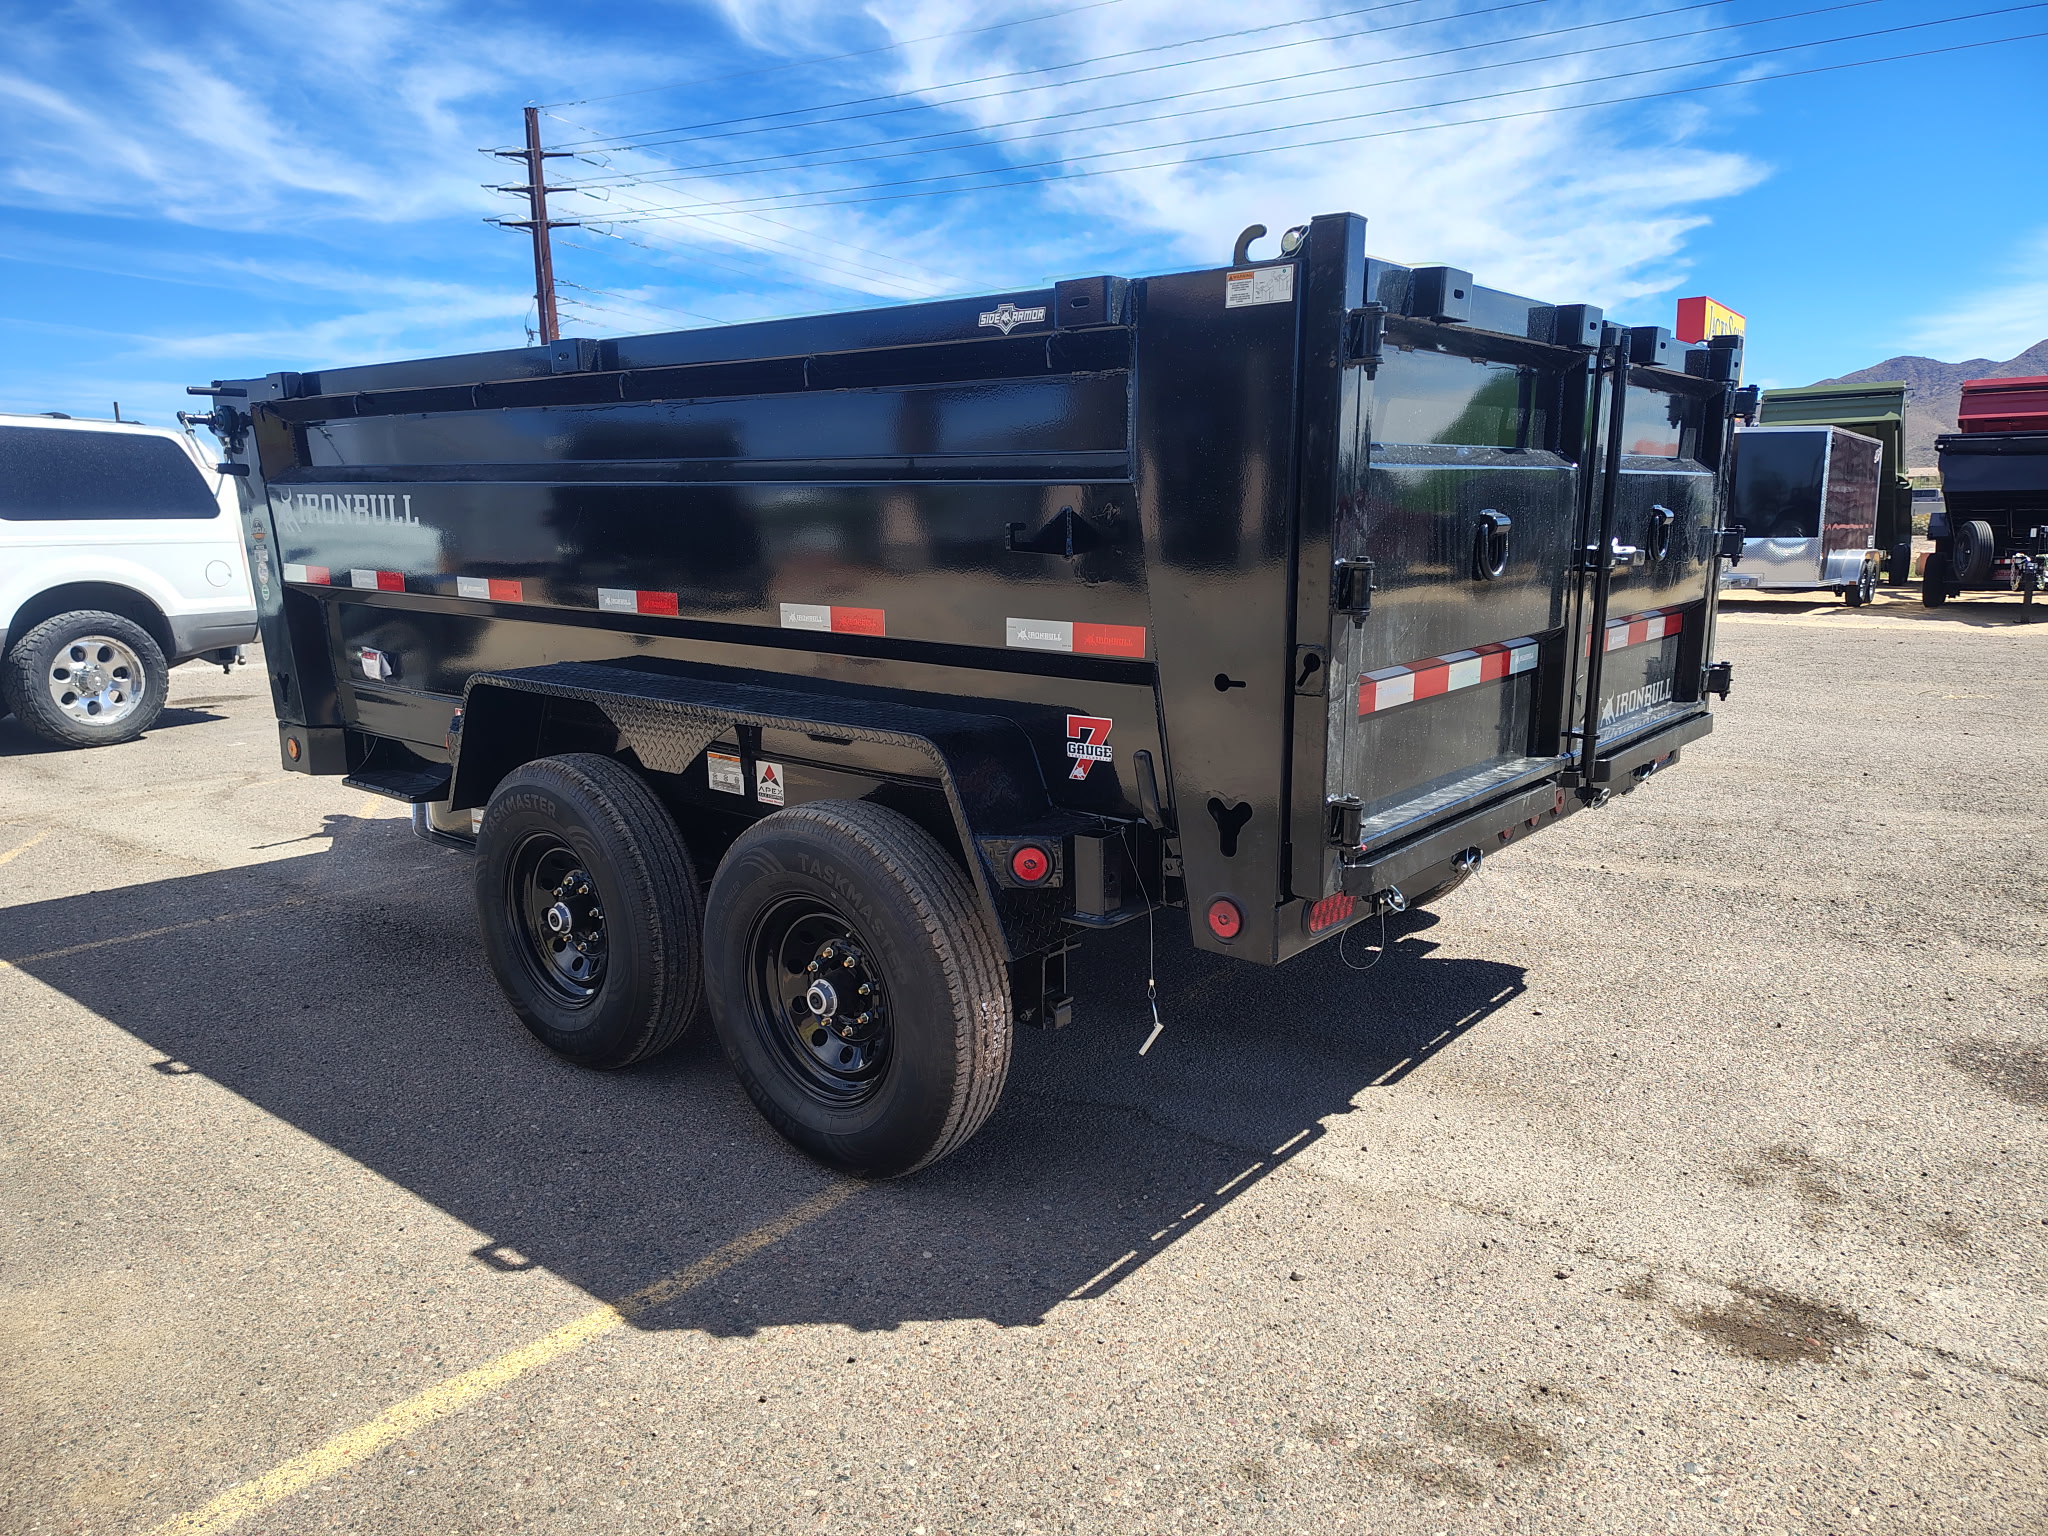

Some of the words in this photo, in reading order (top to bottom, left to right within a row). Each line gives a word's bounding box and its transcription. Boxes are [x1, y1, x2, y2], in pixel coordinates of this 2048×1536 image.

[980, 313, 1000, 325] SIDE
[1012, 308, 1045, 322] ARMOR
[296, 493, 420, 527] IRONBULL
[1028, 631, 1062, 642] IRONBULL
[1095, 636, 1133, 647] IRONBULL
[1615, 678, 1672, 718] IRONBULL
[1067, 714, 1113, 780] 7
[1067, 742, 1112, 759] GAUGE
[758, 786, 783, 796] APEX
[483, 793, 556, 837] TASKMASTER
[798, 852, 909, 985] TASKMASTER
